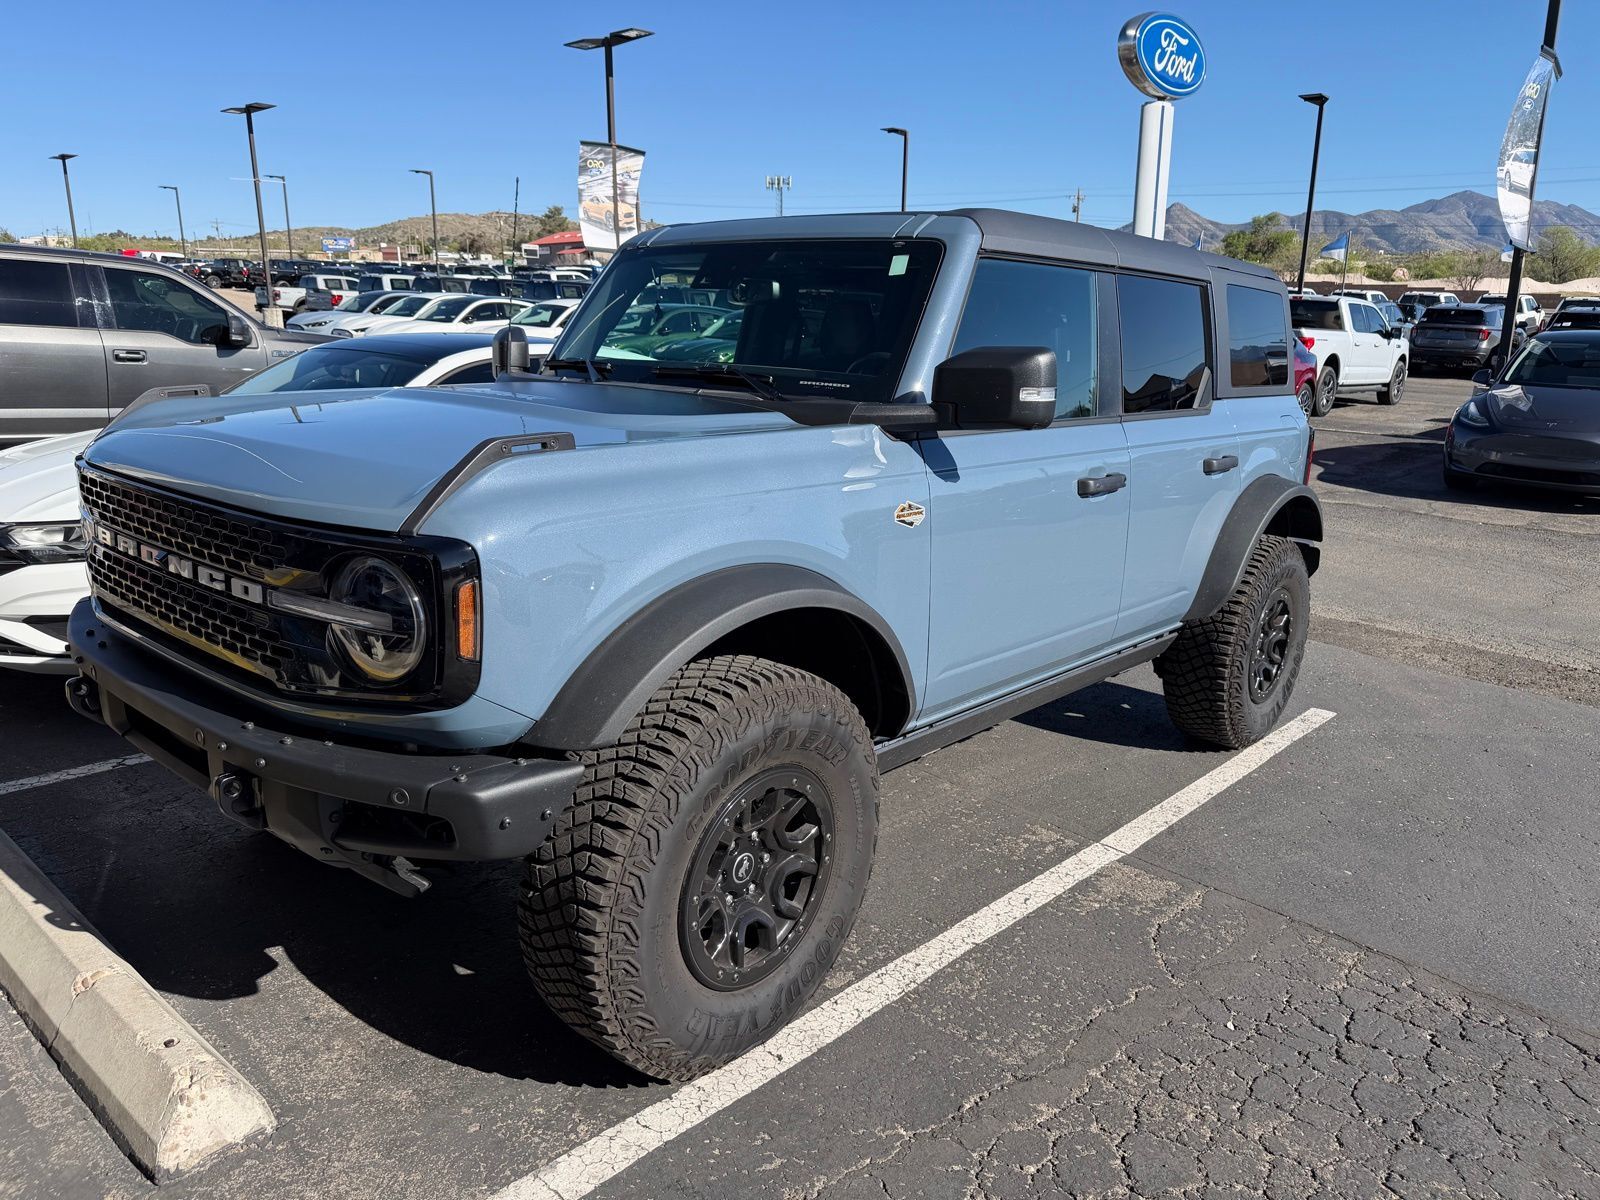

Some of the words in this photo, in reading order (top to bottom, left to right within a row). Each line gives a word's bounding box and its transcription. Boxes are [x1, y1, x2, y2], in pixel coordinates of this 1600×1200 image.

[1154, 28, 1198, 84] Ford
[586, 159, 605, 169] ORO
[97, 525, 264, 604] BRONCO
[685, 728, 849, 841] GOODYEAR
